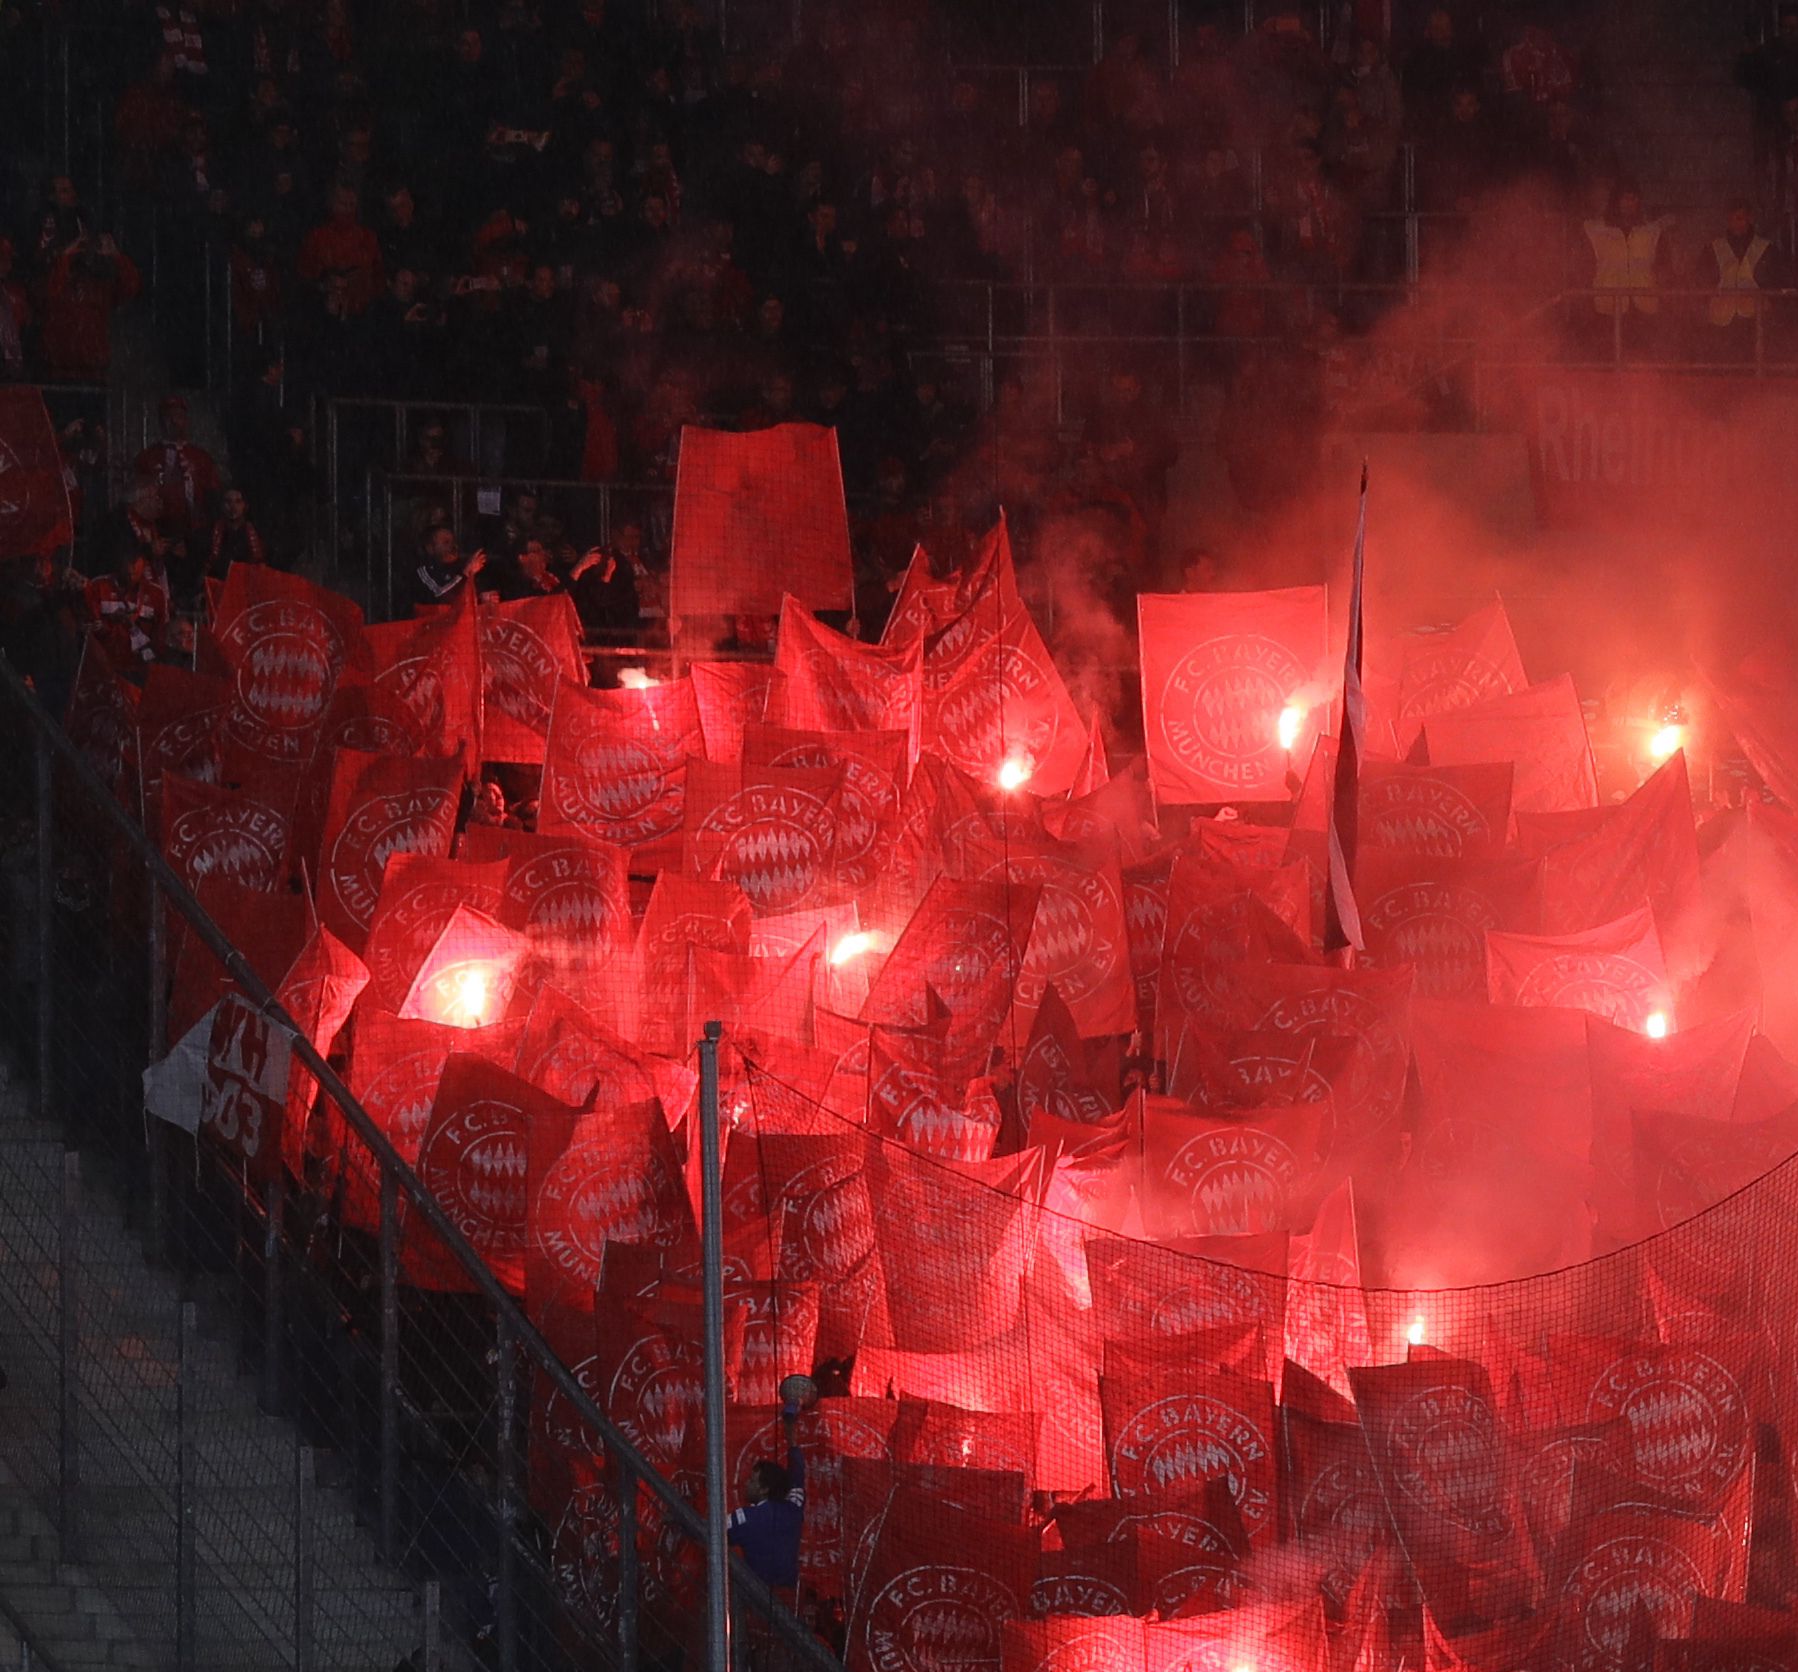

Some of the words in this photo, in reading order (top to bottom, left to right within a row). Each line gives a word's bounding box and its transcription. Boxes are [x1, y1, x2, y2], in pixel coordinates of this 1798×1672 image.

[1167, 718, 1272, 781] MÜNCHEN
[1160, 1403, 1265, 1462] BAYERN
[890, 1577, 932, 1607] F.C.
